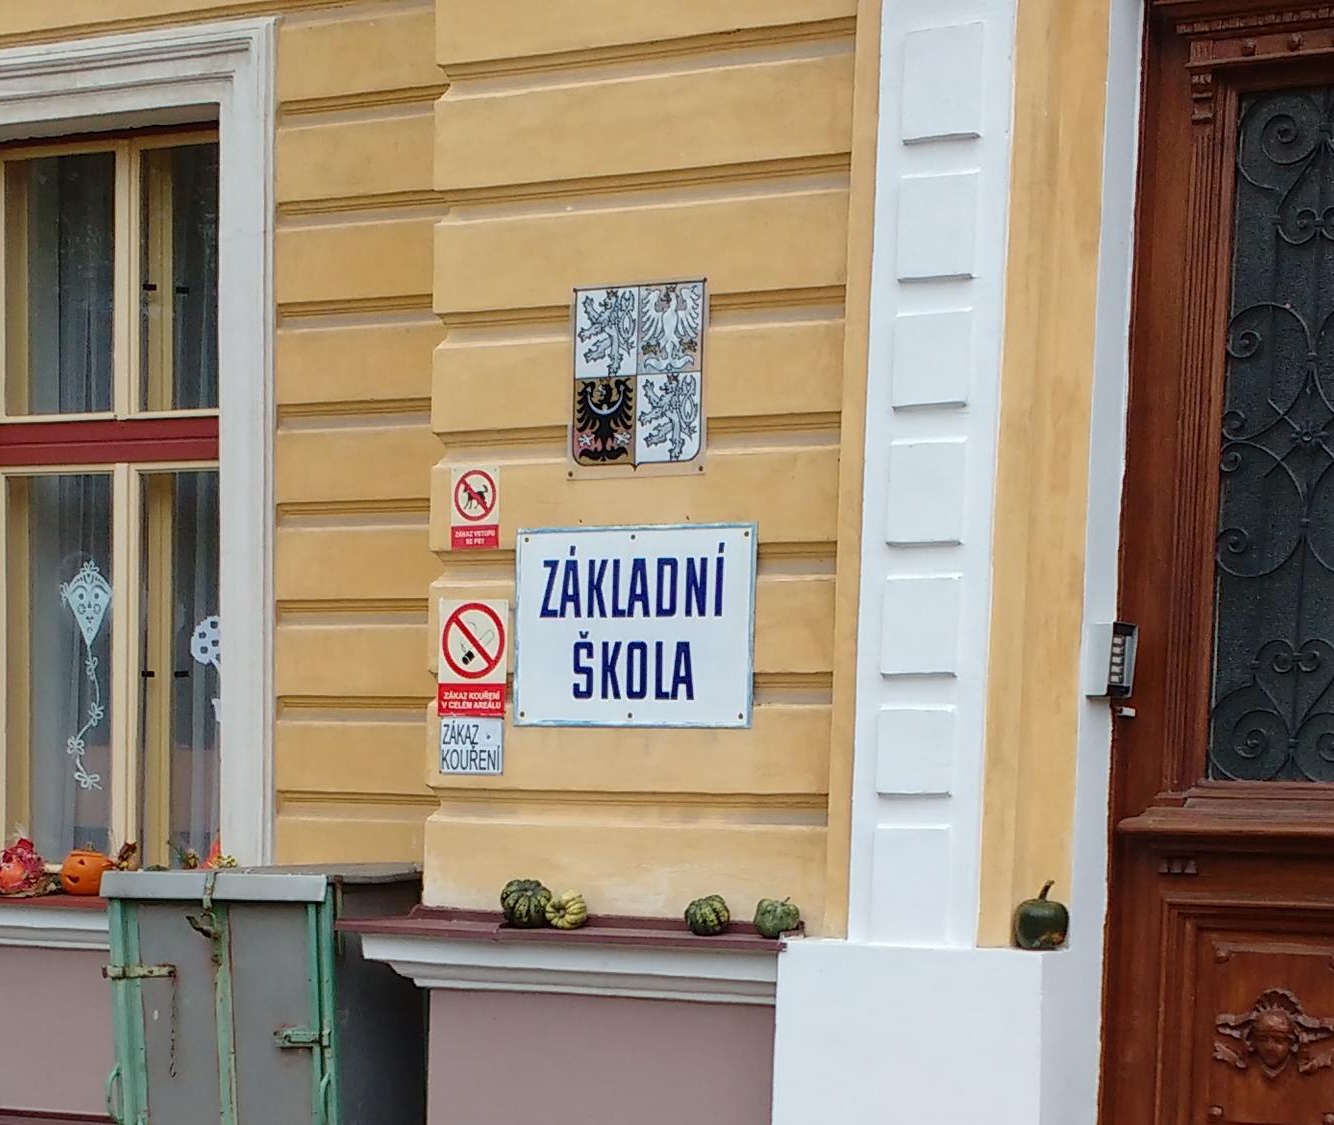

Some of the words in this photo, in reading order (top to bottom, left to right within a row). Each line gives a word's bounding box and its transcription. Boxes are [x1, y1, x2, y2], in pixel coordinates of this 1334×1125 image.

[539, 542, 726, 619] ZÁKLADNÍ
[572, 631, 695, 700] ŠKOLA
[441, 701, 447, 709] V
[448, 701, 473, 709] CELÉM
[473, 701, 502, 709] AREÁLU
[443, 690, 468, 700] ZÁKAZ
[469, 690, 501, 700] KOUŘENÍ
[442, 720, 479, 745] ZÁKAZ
[441, 745, 501, 771] KOUŘENÍ
